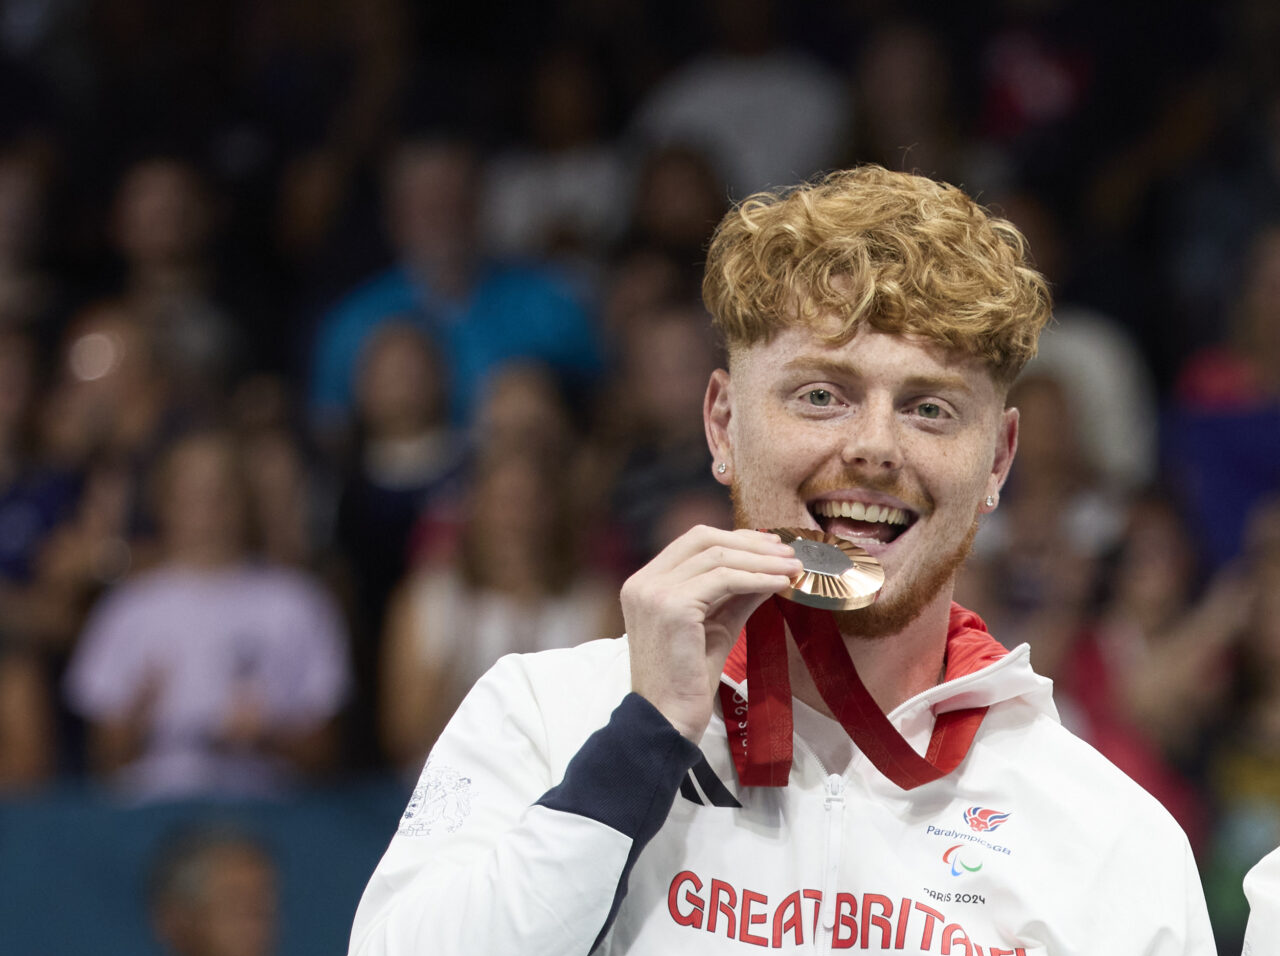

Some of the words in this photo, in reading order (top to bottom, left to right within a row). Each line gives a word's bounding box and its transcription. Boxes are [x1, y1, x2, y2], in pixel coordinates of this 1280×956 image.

[926, 825, 1012, 855] ParalympicsGB
[667, 870, 823, 949] GREAT
[954, 893, 986, 905] 2024
